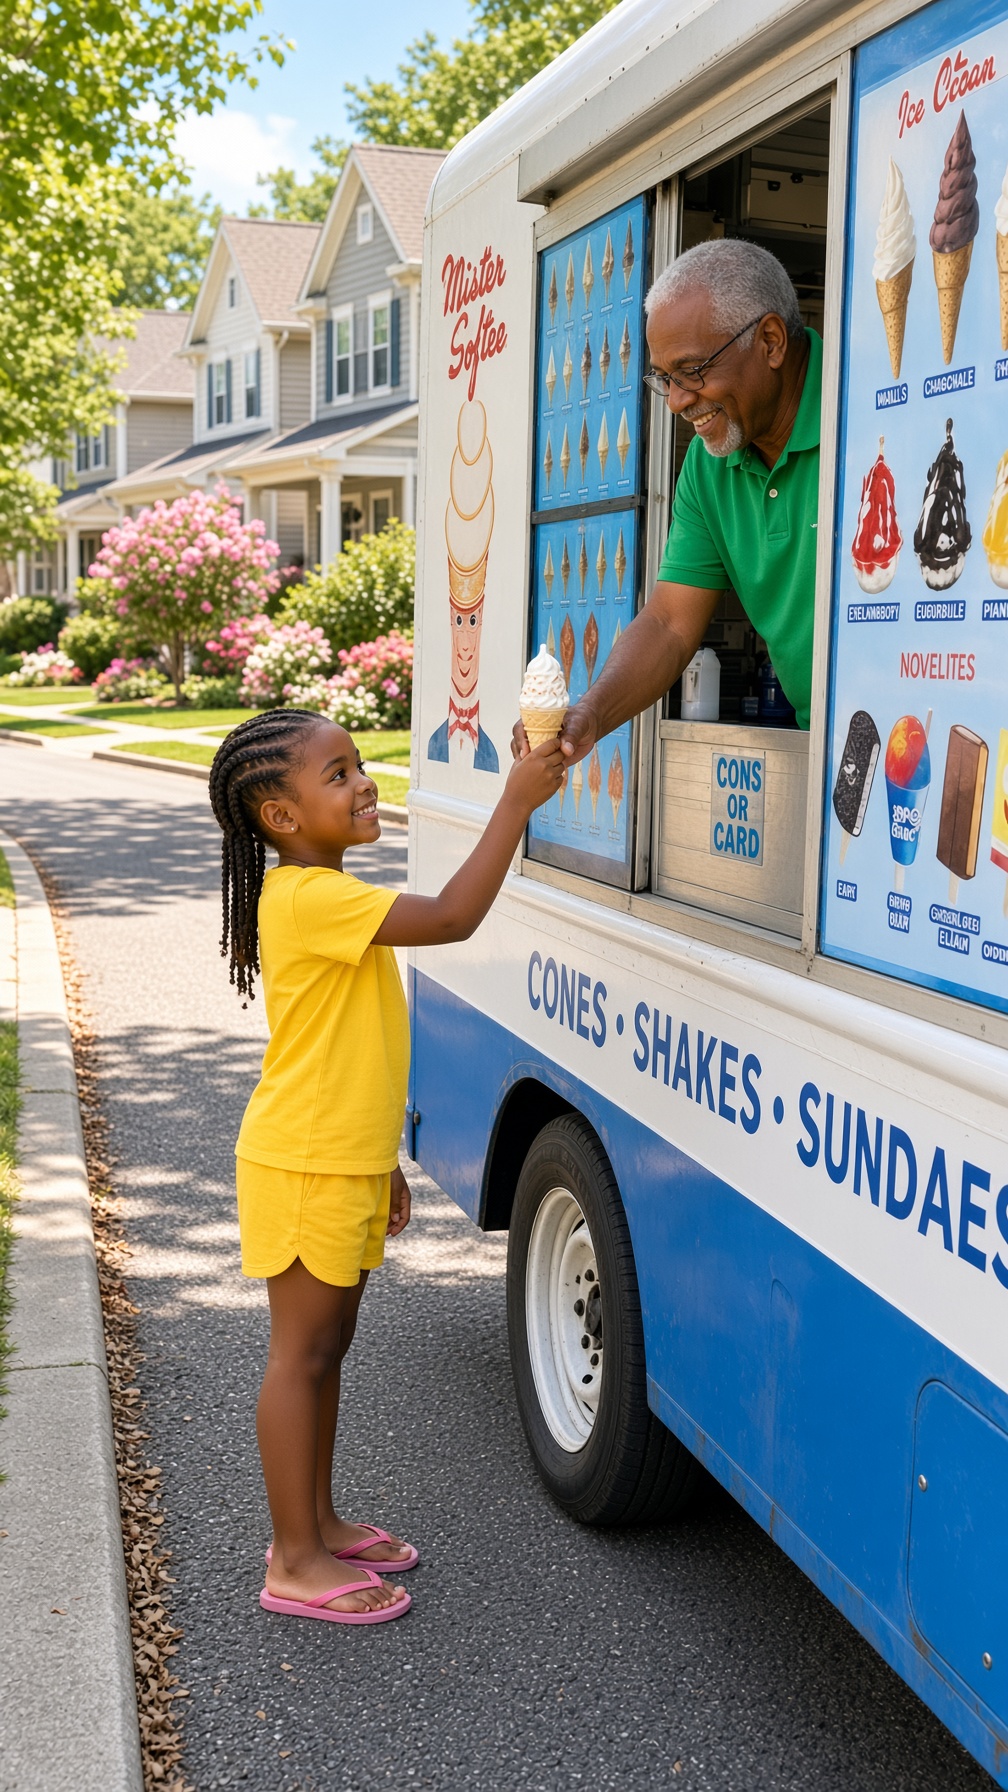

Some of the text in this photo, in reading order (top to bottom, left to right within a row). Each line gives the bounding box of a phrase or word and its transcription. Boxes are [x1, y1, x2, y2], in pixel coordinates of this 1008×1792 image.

[898, 90, 926, 139] Ice
[441, 245, 507, 317] Mister
[448, 304, 508, 402] Softee
[900, 652, 975, 681] NOVELITES
[716, 756, 762, 793] CONS
[727, 793, 749, 822] OR
[713, 821, 760, 859] CARD
[528, 950, 608, 1048] CONES
[633, 1001, 762, 1135] SHAKES
